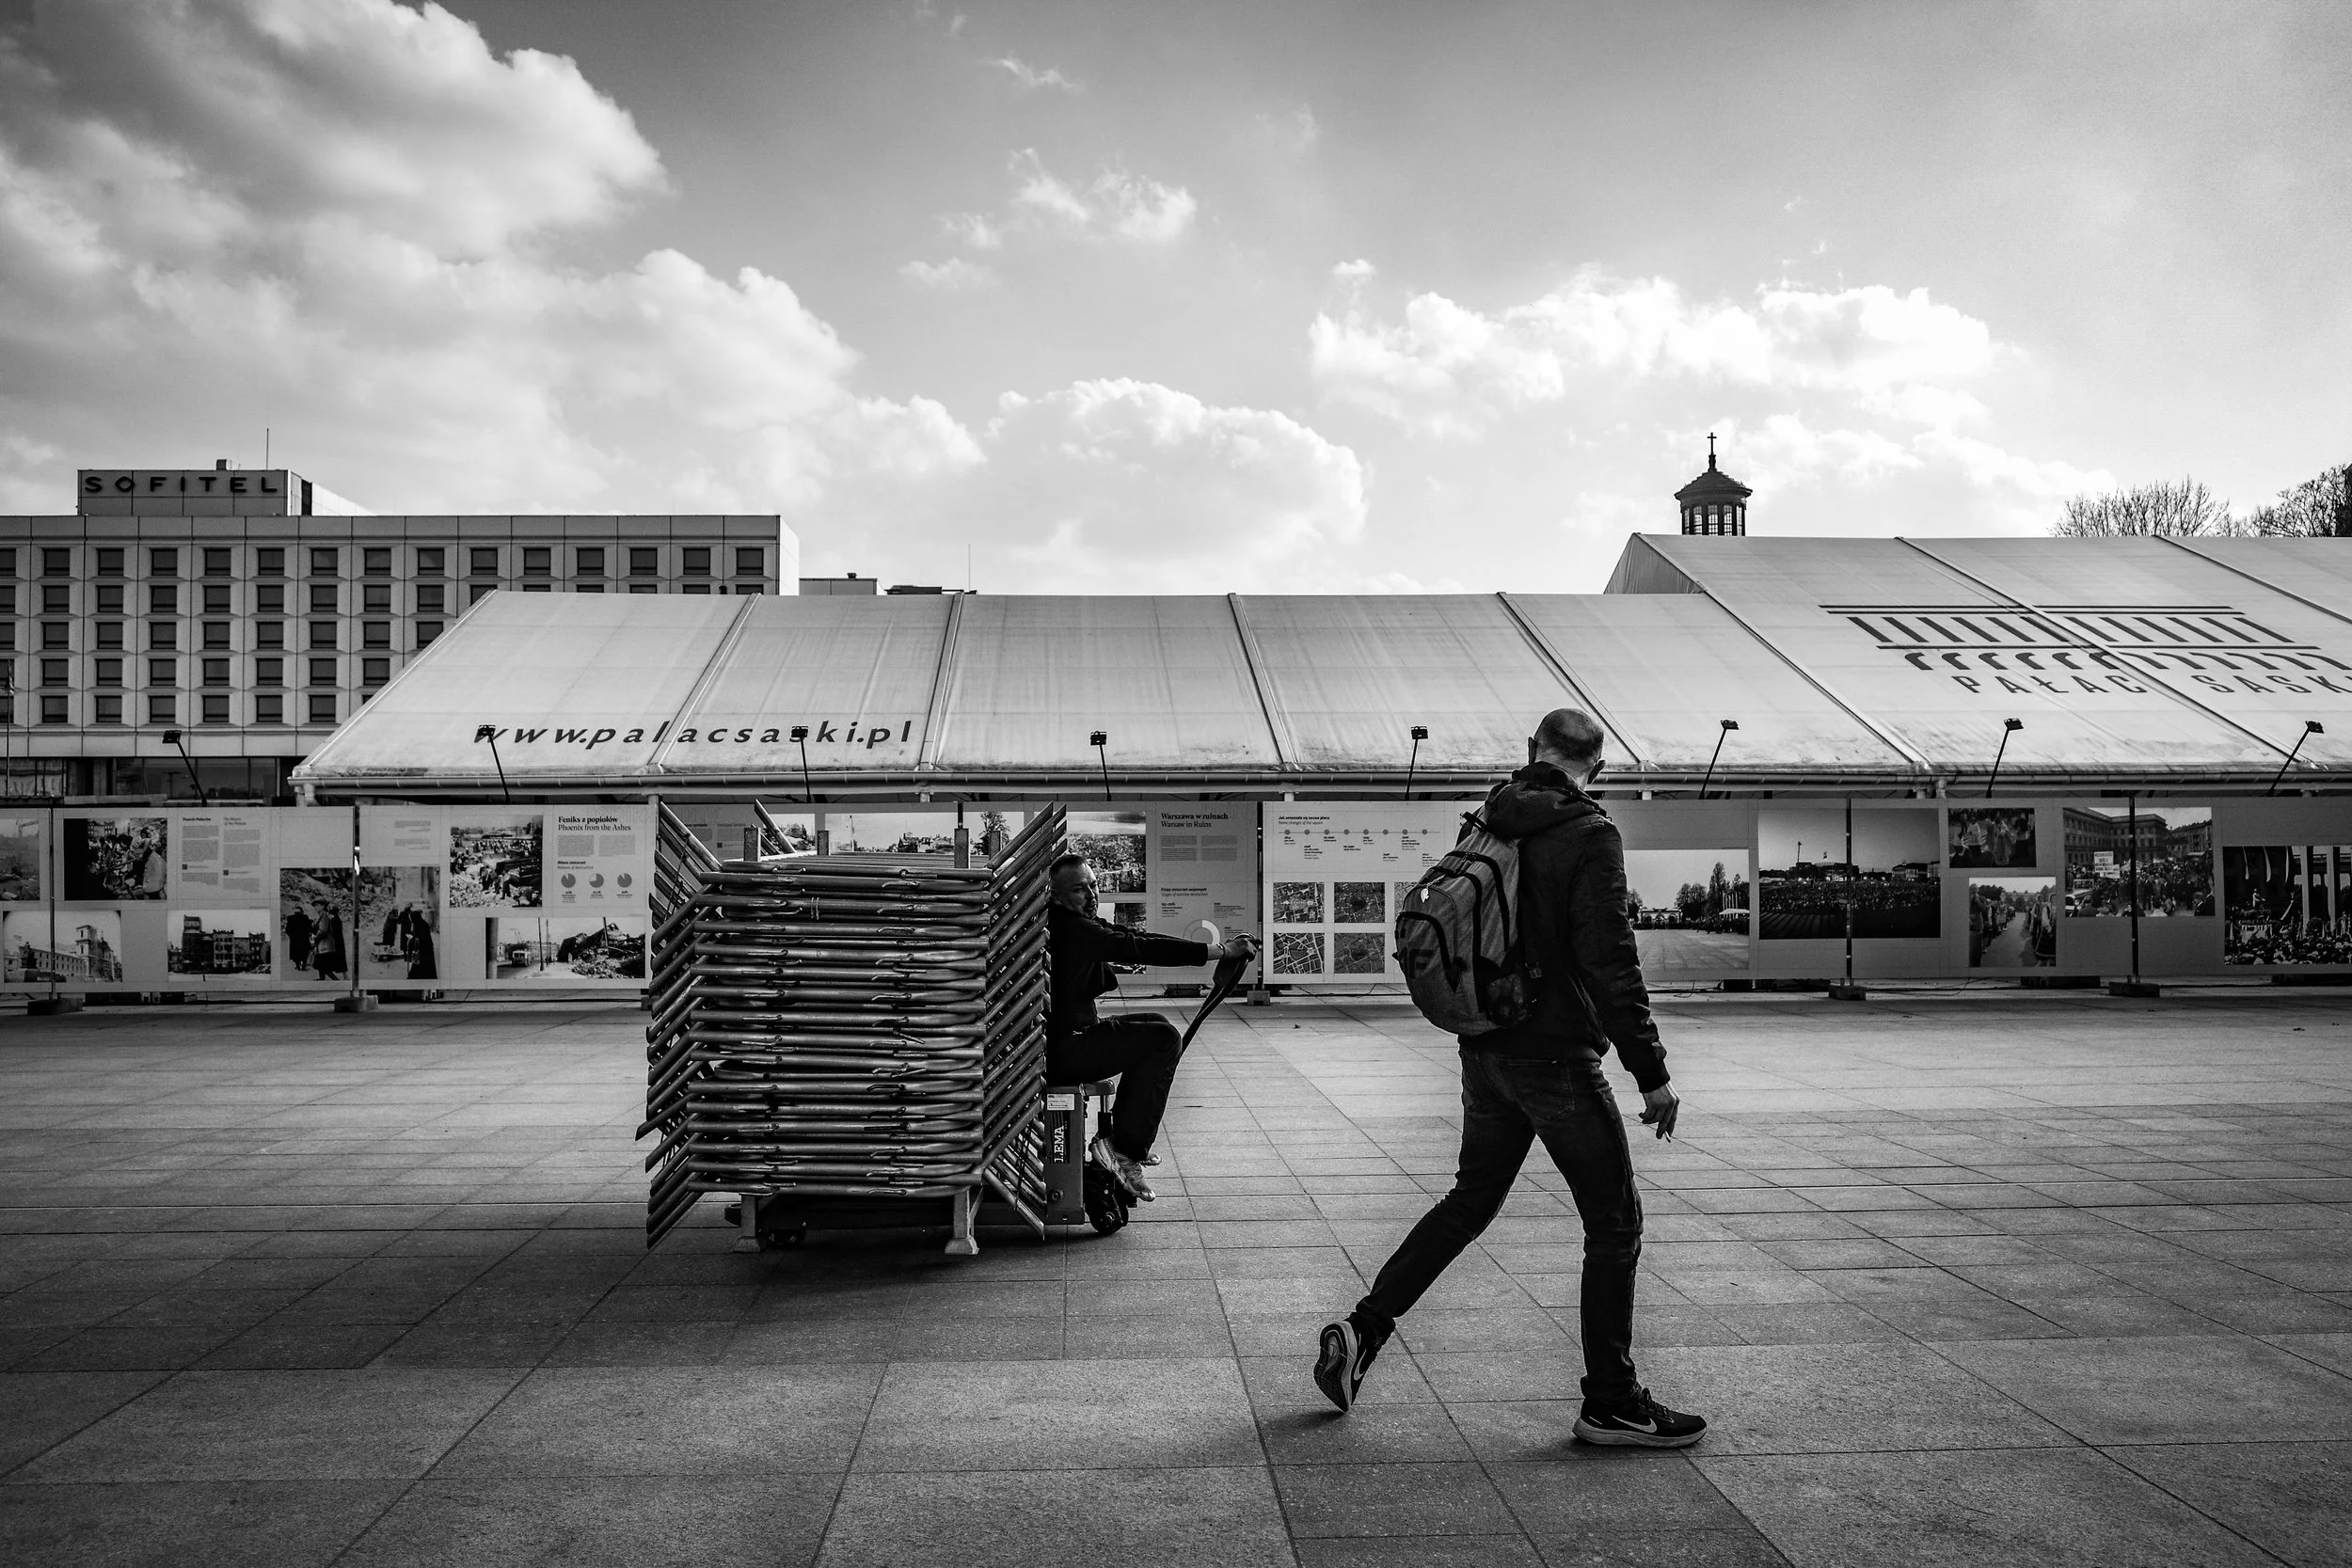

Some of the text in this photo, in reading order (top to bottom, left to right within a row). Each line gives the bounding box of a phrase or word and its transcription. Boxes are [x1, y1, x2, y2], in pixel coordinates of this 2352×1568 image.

[85, 475, 278, 494] SOFITEL
[1950, 674, 2352, 694] PAŁAC SASK
